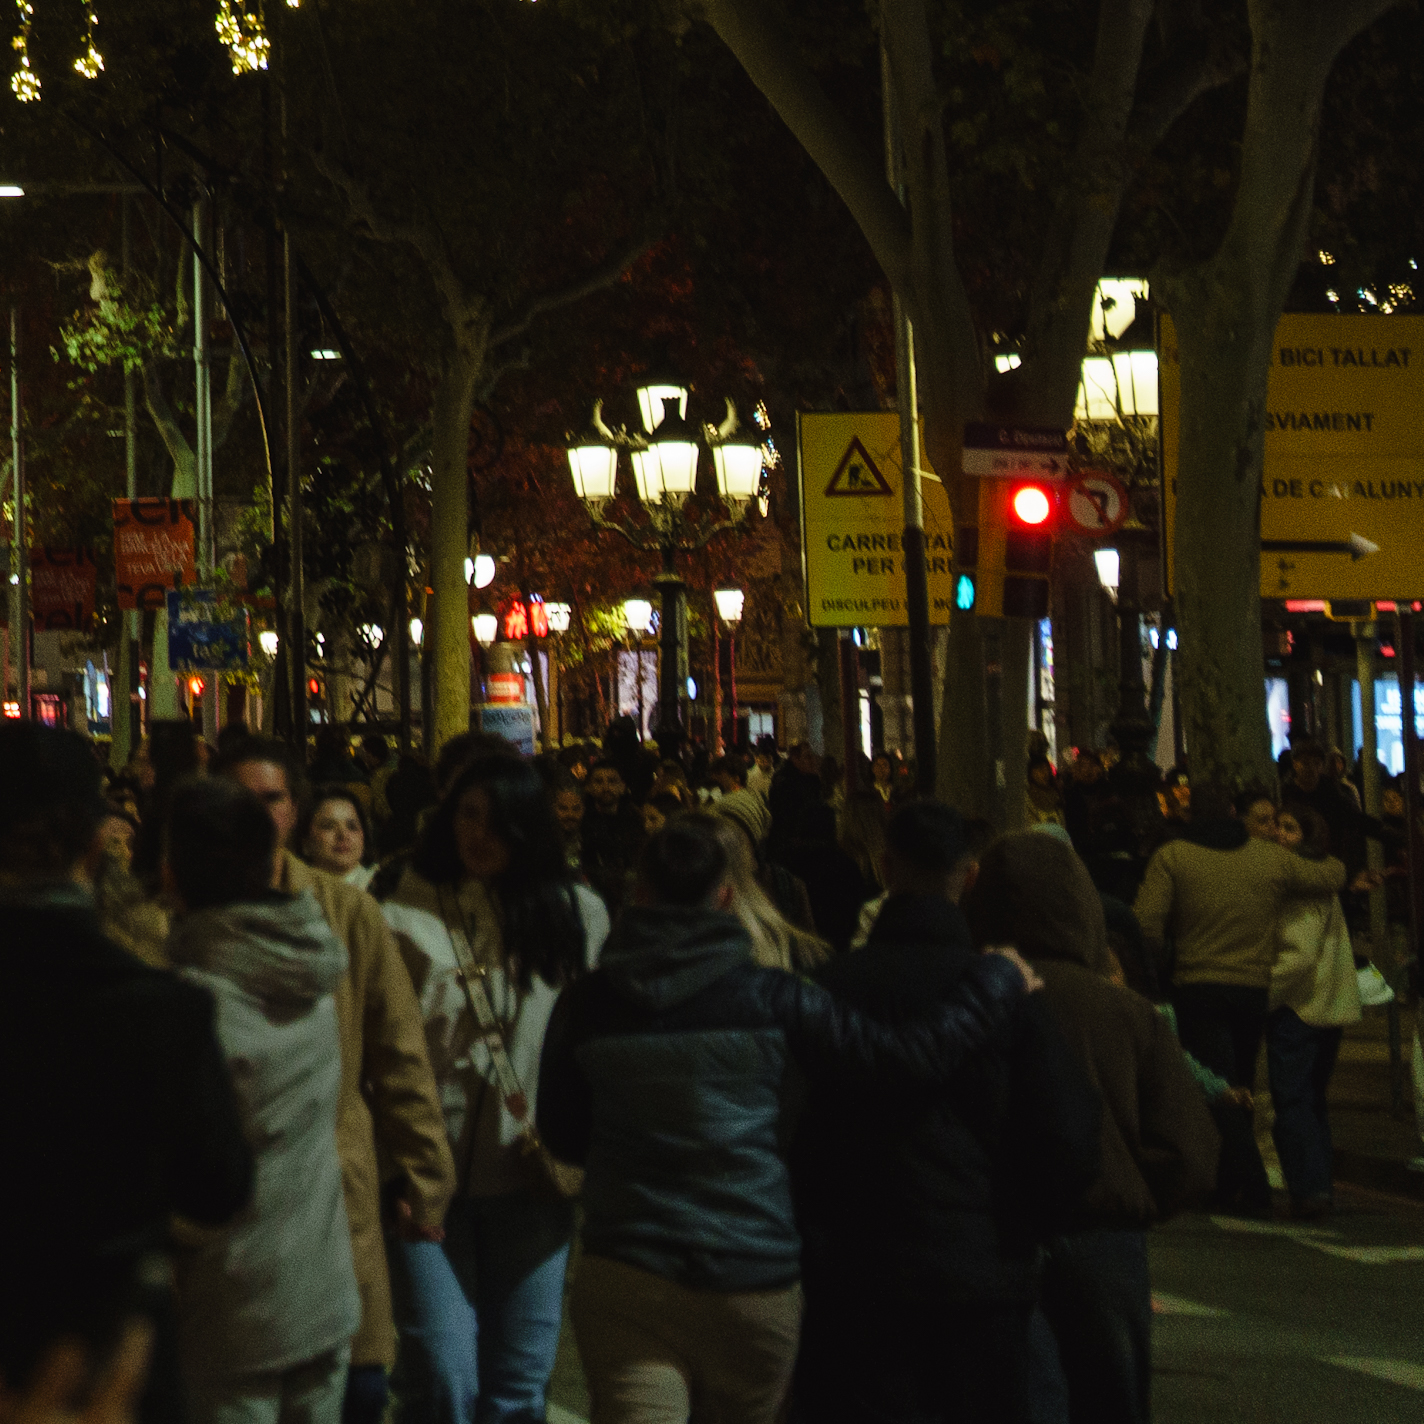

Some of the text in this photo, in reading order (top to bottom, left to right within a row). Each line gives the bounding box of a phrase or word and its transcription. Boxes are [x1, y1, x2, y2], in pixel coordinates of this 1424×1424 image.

[1280, 347, 1412, 367] BICI TALLAT
[1265, 412, 1375, 432] SVIAMENT
[1273, 479, 1303, 498] DE
[827, 533, 907, 552] CARRE
[853, 557, 895, 575] PER
[821, 598, 900, 612] DISCULPEU
